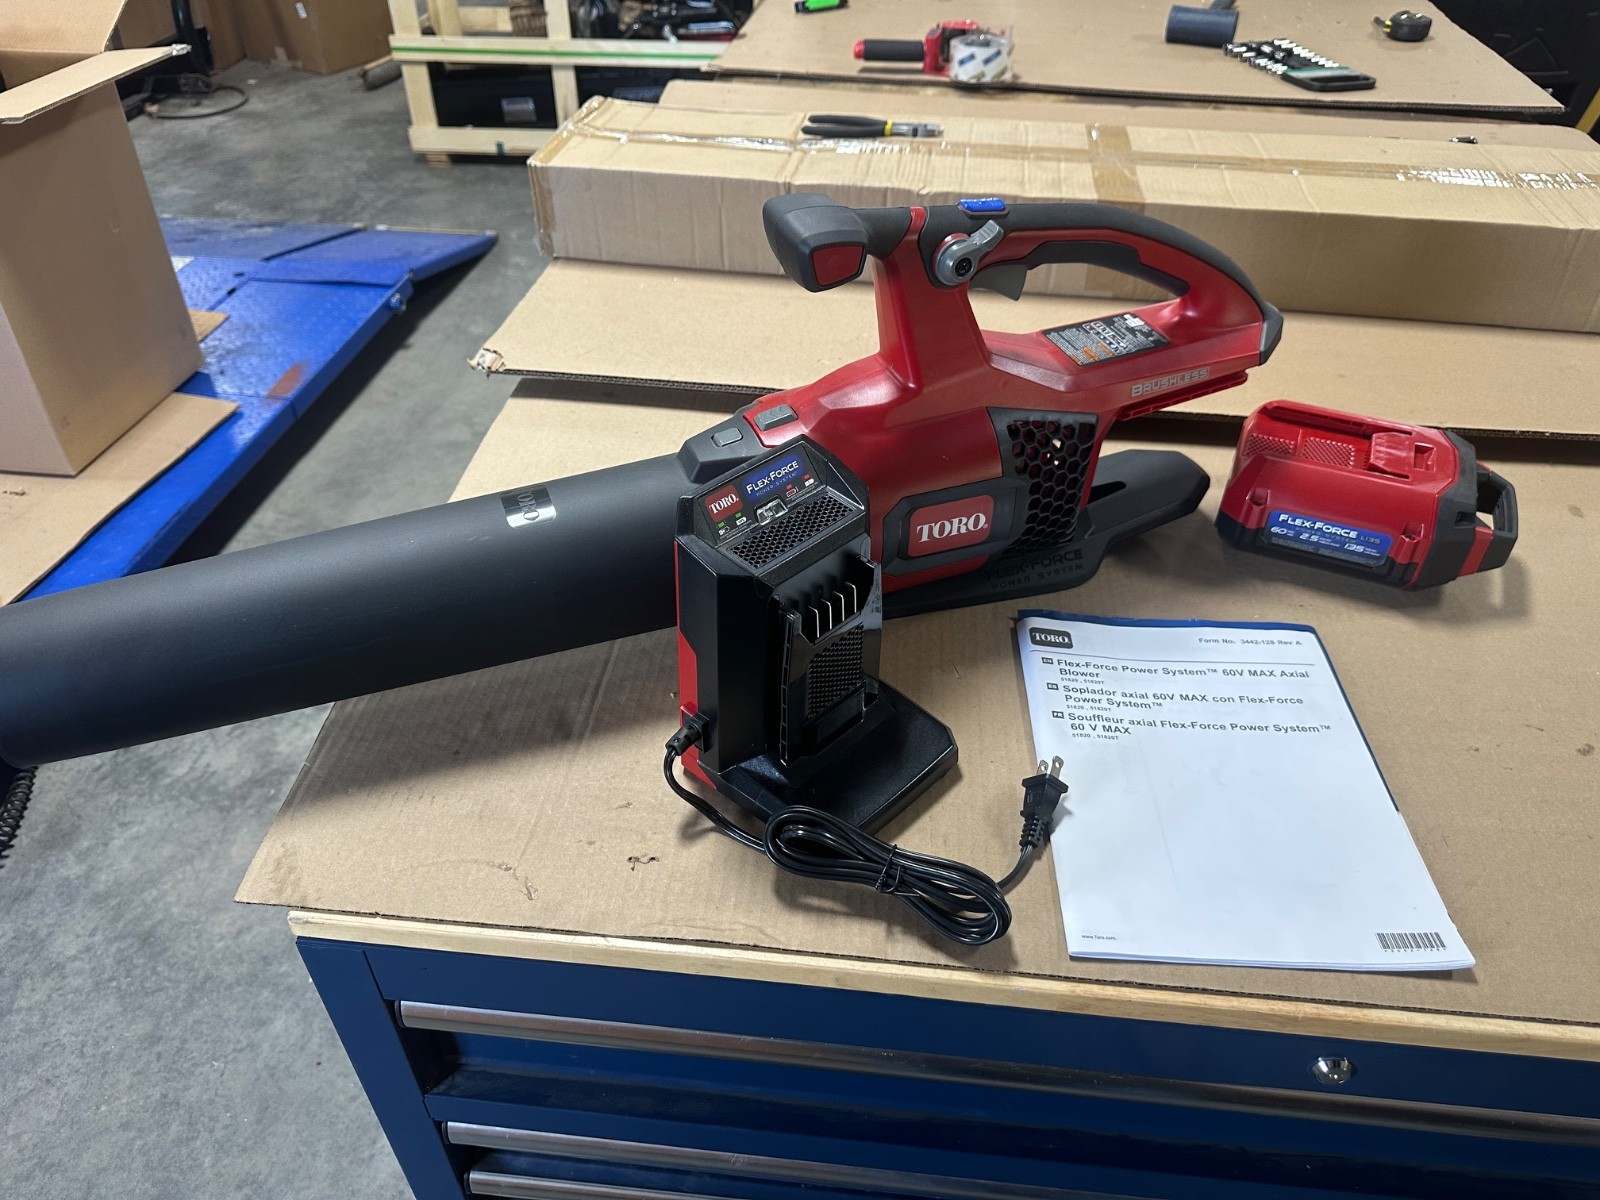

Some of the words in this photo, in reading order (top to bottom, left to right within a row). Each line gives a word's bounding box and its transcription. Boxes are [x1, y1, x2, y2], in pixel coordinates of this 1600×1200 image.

[1131, 368, 1208, 397] BRUSHLESS
[746, 460, 799, 494] FLEX-FORCE
[709, 493, 737, 514] TORO
[917, 512, 986, 543] TORO
[1279, 513, 1358, 539] FLEX-FORCE
[1032, 632, 1069, 644] TORO
[1057, 659, 1118, 672] Flex-Force
[1121, 665, 1158, 675] Power
[1222, 668, 1244, 677] 60V
[1248, 669, 1277, 678] MAX
[1280, 669, 1310, 678] Axial
[1059, 668, 1100, 678] Blower
[1063, 684, 1117, 697] Soplador
[1121, 691, 1149, 700] axial
[1152, 692, 1175, 701] 60V
[1179, 694, 1209, 702] MAX
[1238, 695, 1304, 705] Flex-Force
[1064, 694, 1102, 704] Power
[1068, 712, 1124, 724] Souffleur
[1128, 718, 1157, 727] axial
[1160, 720, 1226, 731] Flex-Force
[1230, 723, 1269, 732] Power
[1070, 722, 1085, 731] 60
[1102, 724, 1132, 735] MAX
